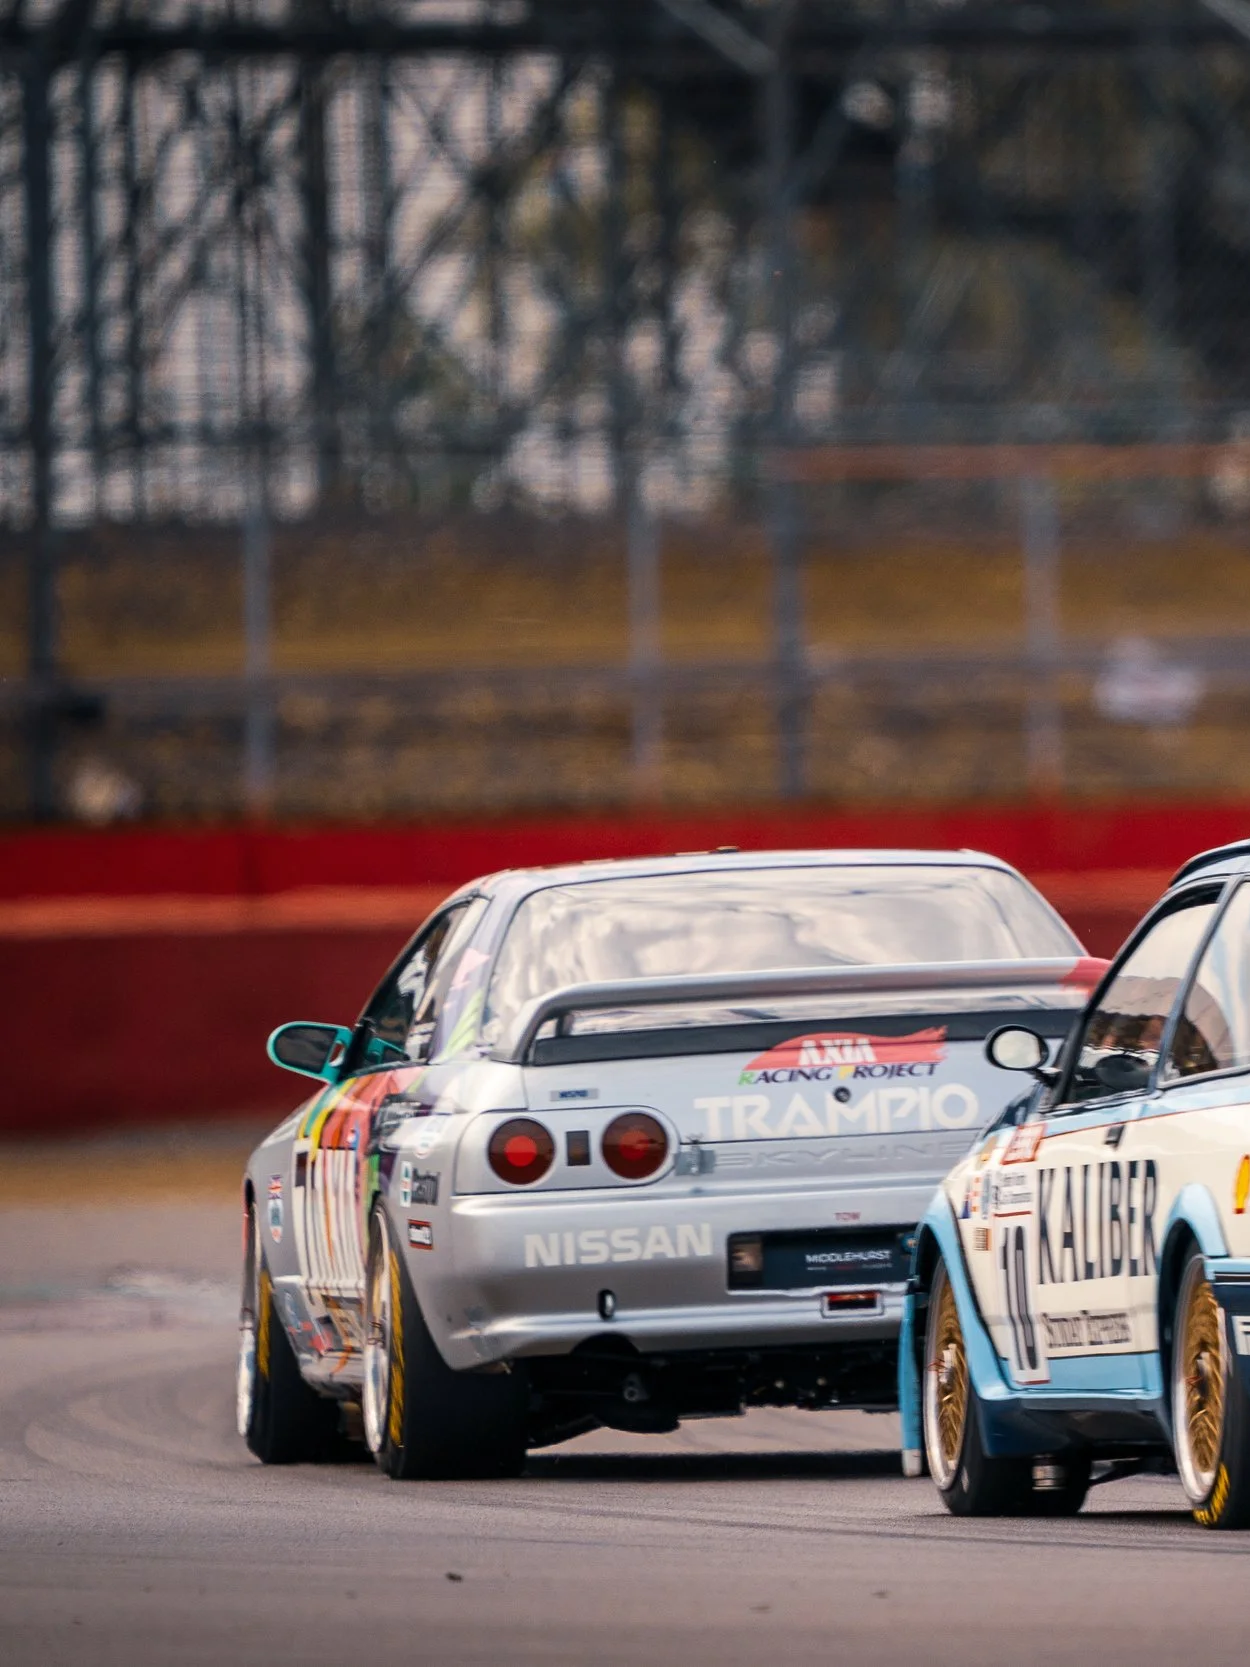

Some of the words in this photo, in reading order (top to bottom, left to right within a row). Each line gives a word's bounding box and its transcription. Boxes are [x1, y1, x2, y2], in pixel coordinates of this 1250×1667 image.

[797, 1038, 877, 1067] AXIA
[738, 1067, 832, 1086] RACING
[838, 1062, 940, 1081] PROJECT
[693, 1083, 979, 1140] TRAMPIO
[716, 1140, 969, 1169] SKYLINE
[1038, 1159, 1159, 1285] KALIBER
[523, 1223, 713, 1268] NISSAN
[805, 1250, 893, 1264] MIDDLEHURST
